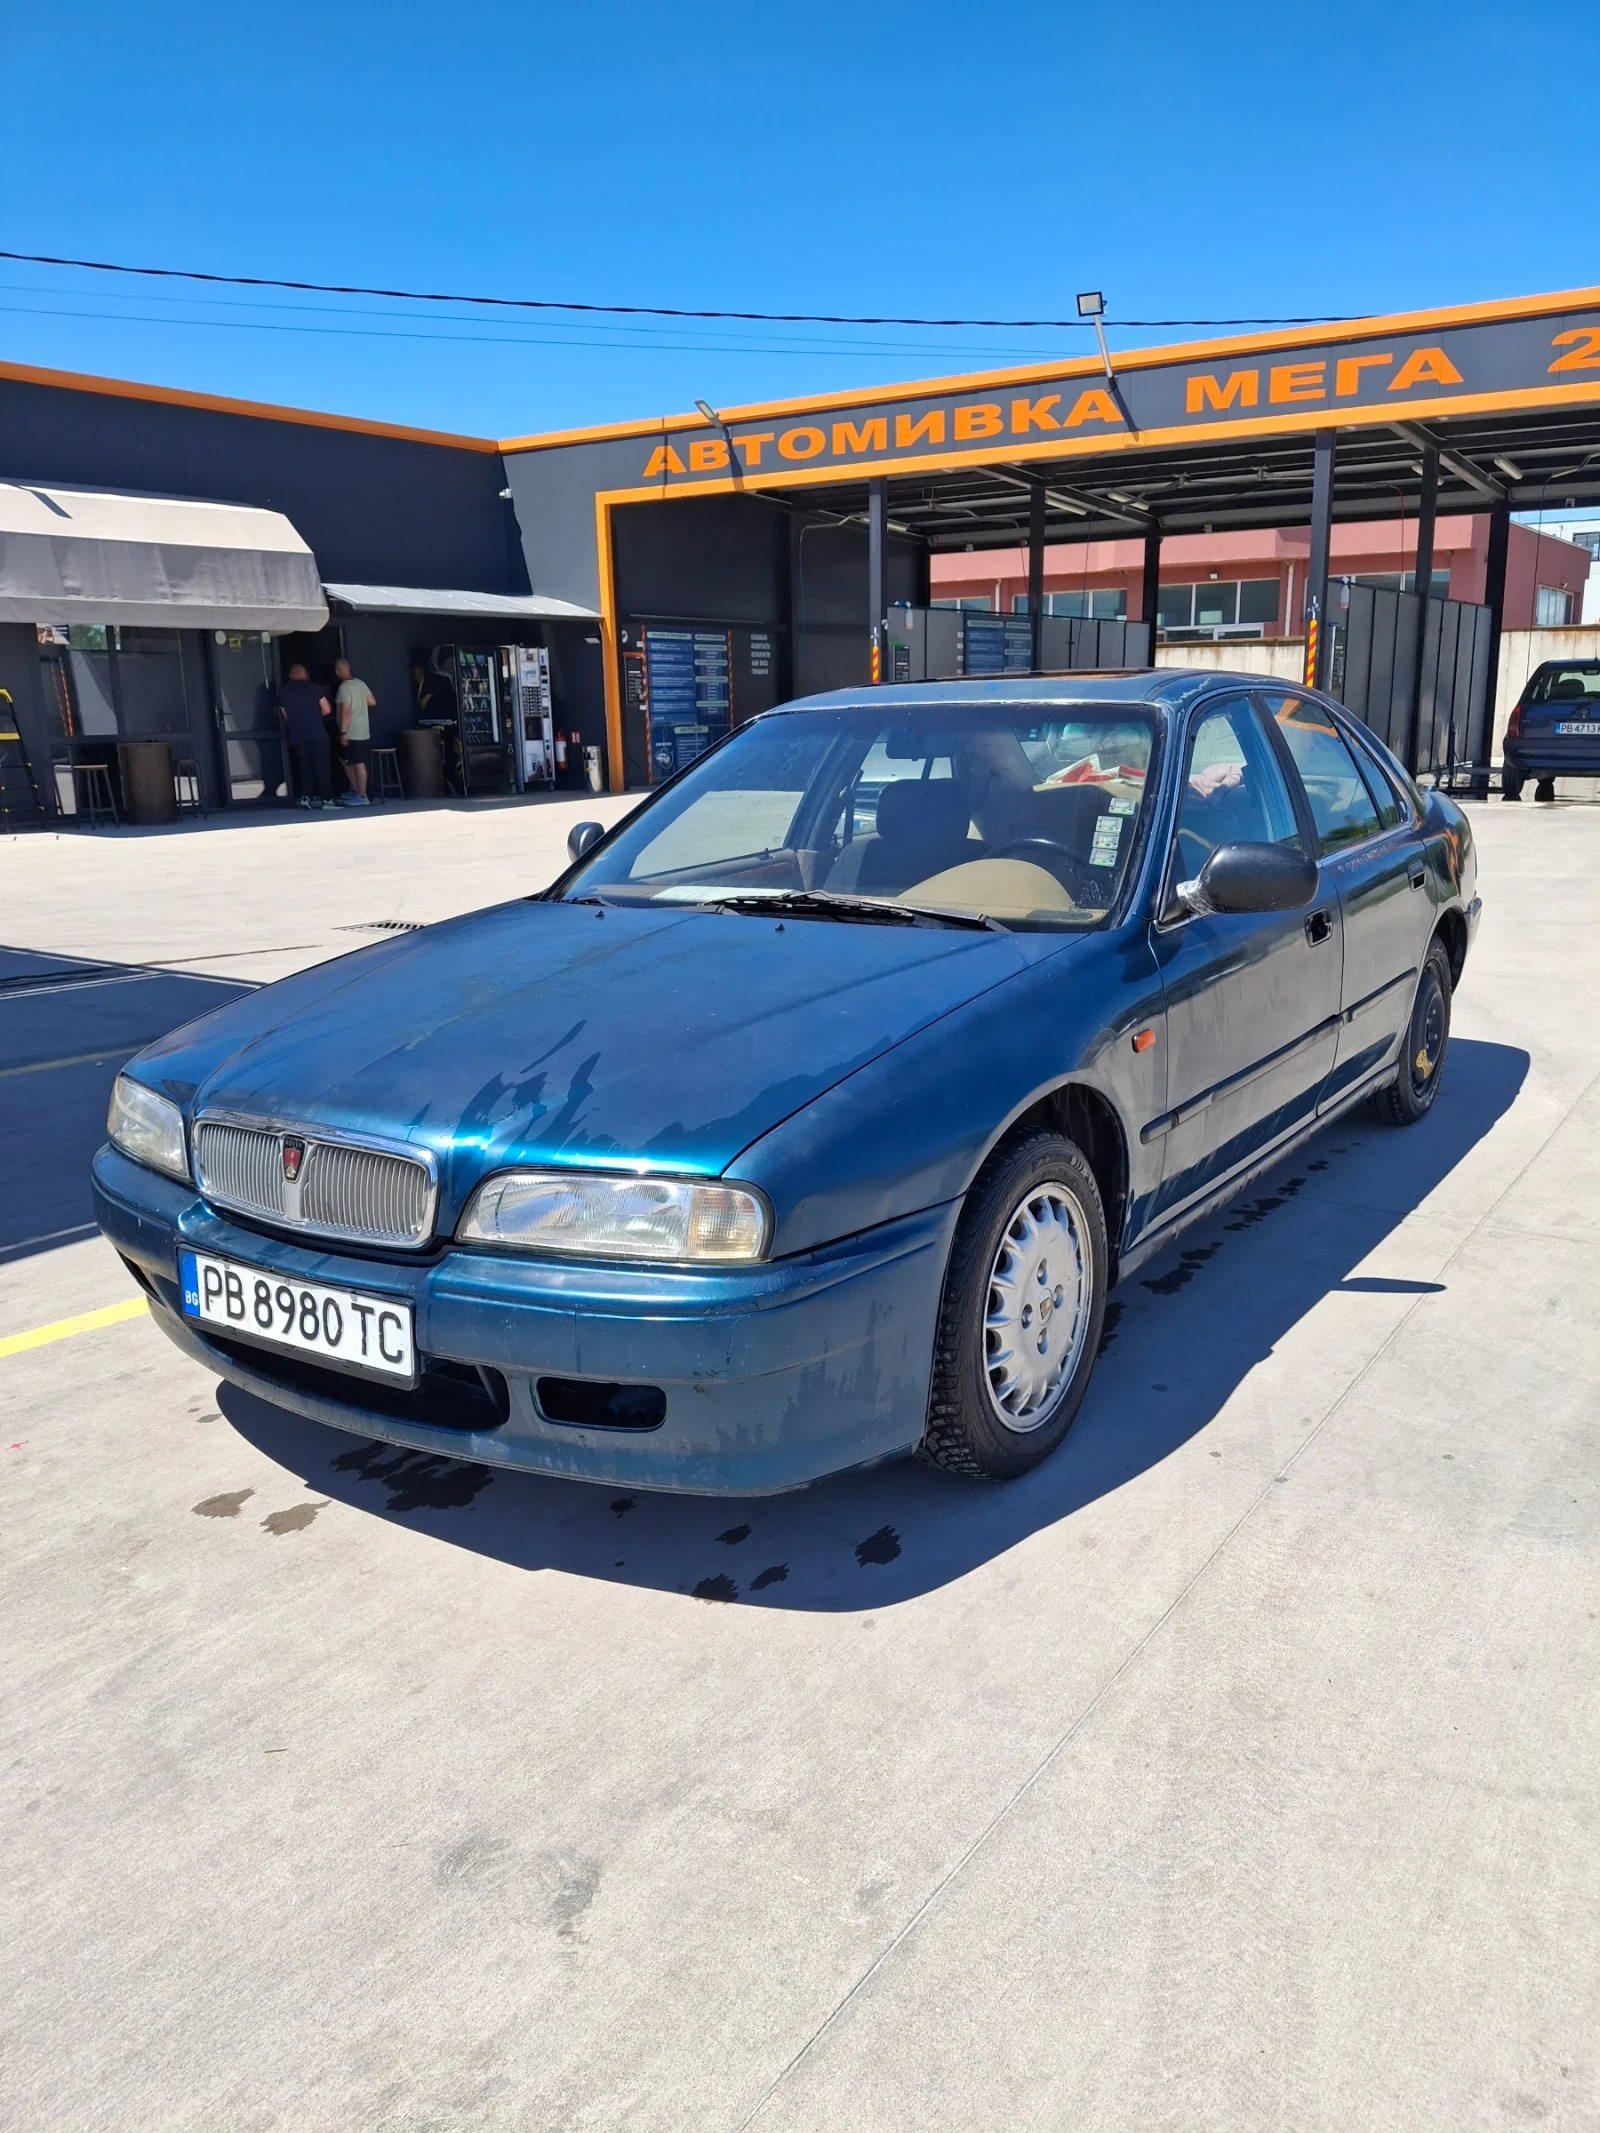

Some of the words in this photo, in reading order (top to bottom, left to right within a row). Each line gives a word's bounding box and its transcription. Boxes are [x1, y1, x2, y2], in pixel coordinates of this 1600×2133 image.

[642, 388, 1124, 478] АВТОМИВКА
[1185, 347, 1465, 413] МЕГА
[1575, 724, 1596, 733] 4713
[285, 1139, 302, 1149] ROVER
[185, 1289, 199, 1307] BG
[203, 1265, 245, 1320] PB
[254, 1279, 343, 1347] 8980
[351, 1302, 403, 1364] TC
